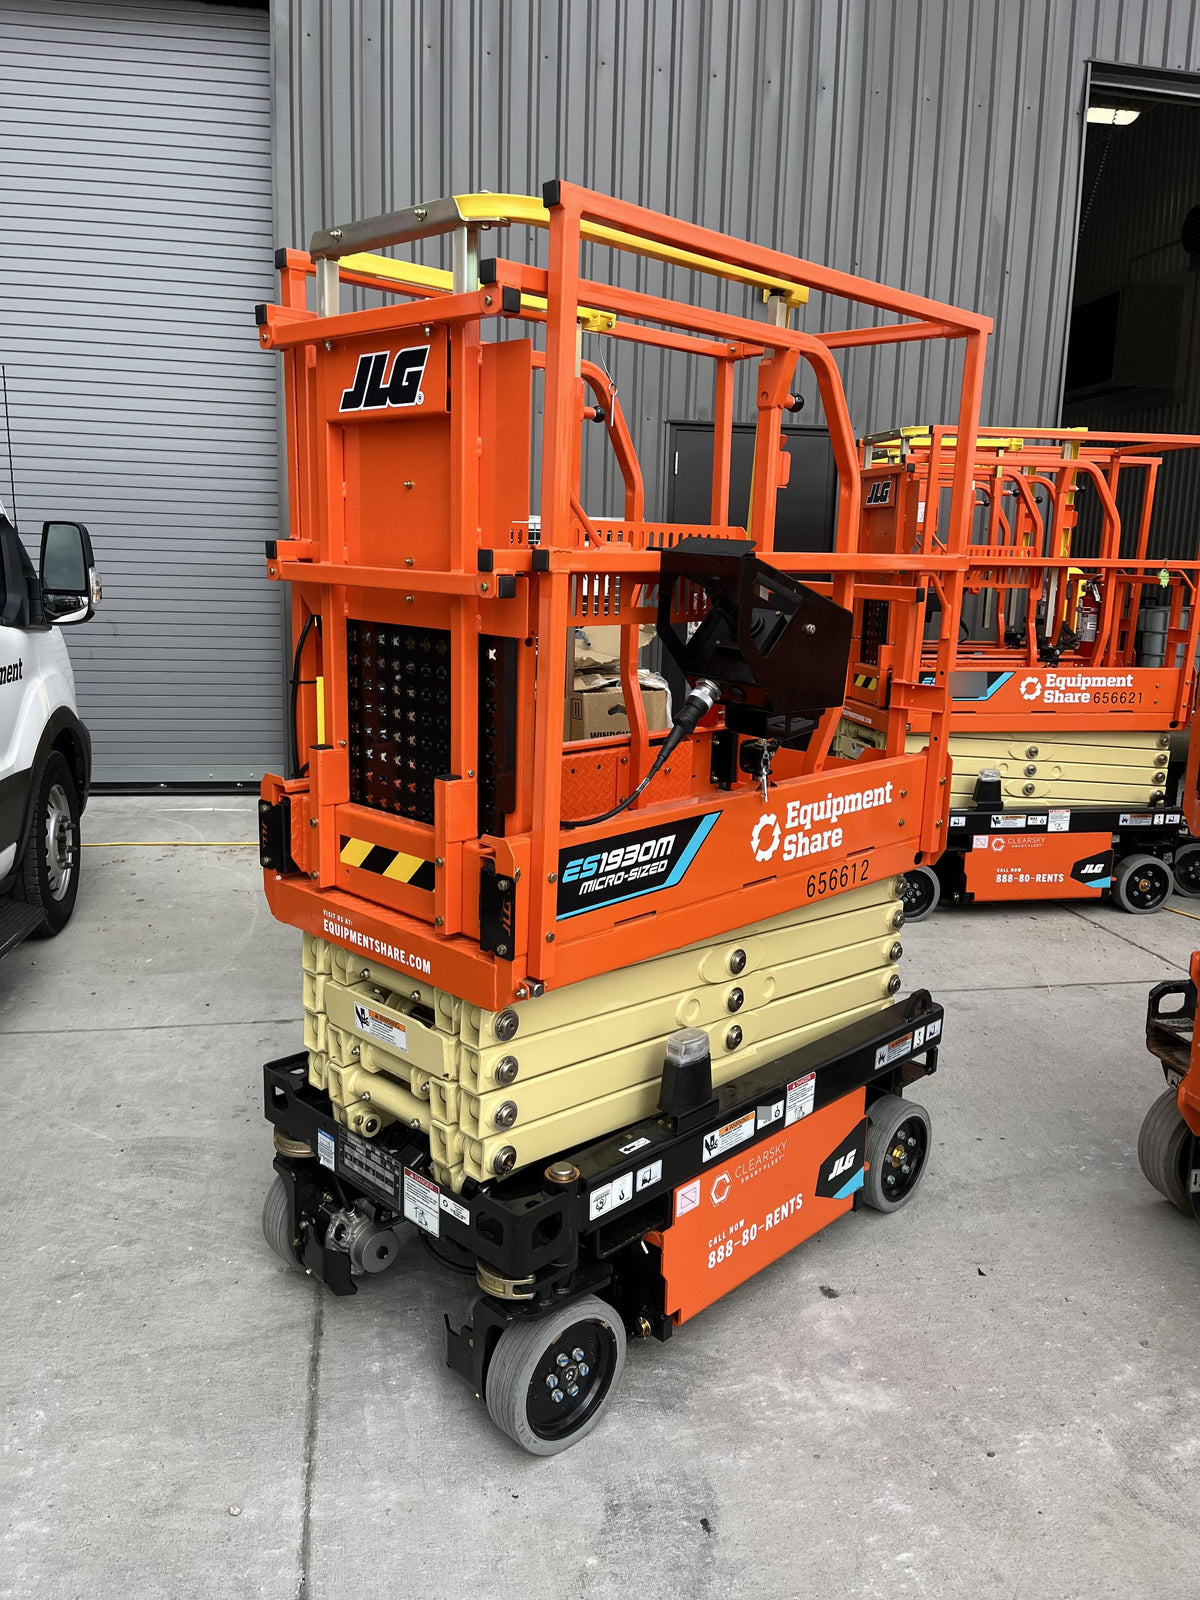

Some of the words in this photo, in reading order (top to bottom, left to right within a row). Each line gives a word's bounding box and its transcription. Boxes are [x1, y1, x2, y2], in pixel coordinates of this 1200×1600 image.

[339, 345, 431, 412] JLG
[866, 481, 892, 505] JLG
[1043, 690, 1090, 704] Share
[1093, 691, 1143, 704] 656621
[1045, 673, 1134, 688] Equipment
[785, 781, 894, 831] Equipment
[562, 834, 677, 883] ES1930M
[782, 827, 843, 862] Share
[578, 859, 669, 896] MICRO-SIZED
[806, 859, 870, 898] 656612
[995, 873, 1065, 883] 888-80-RENTS
[1080, 863, 1105, 874] JLG
[323, 918, 431, 975] EQUIPMENTSHARE.COM
[734, 1138, 788, 1179] CLEARSKY
[828, 1148, 857, 1182] JLG
[707, 1193, 804, 1269] 888-80-RENTS
[708, 1231, 727, 1248] CALL
[728, 1218, 745, 1235] NOW
